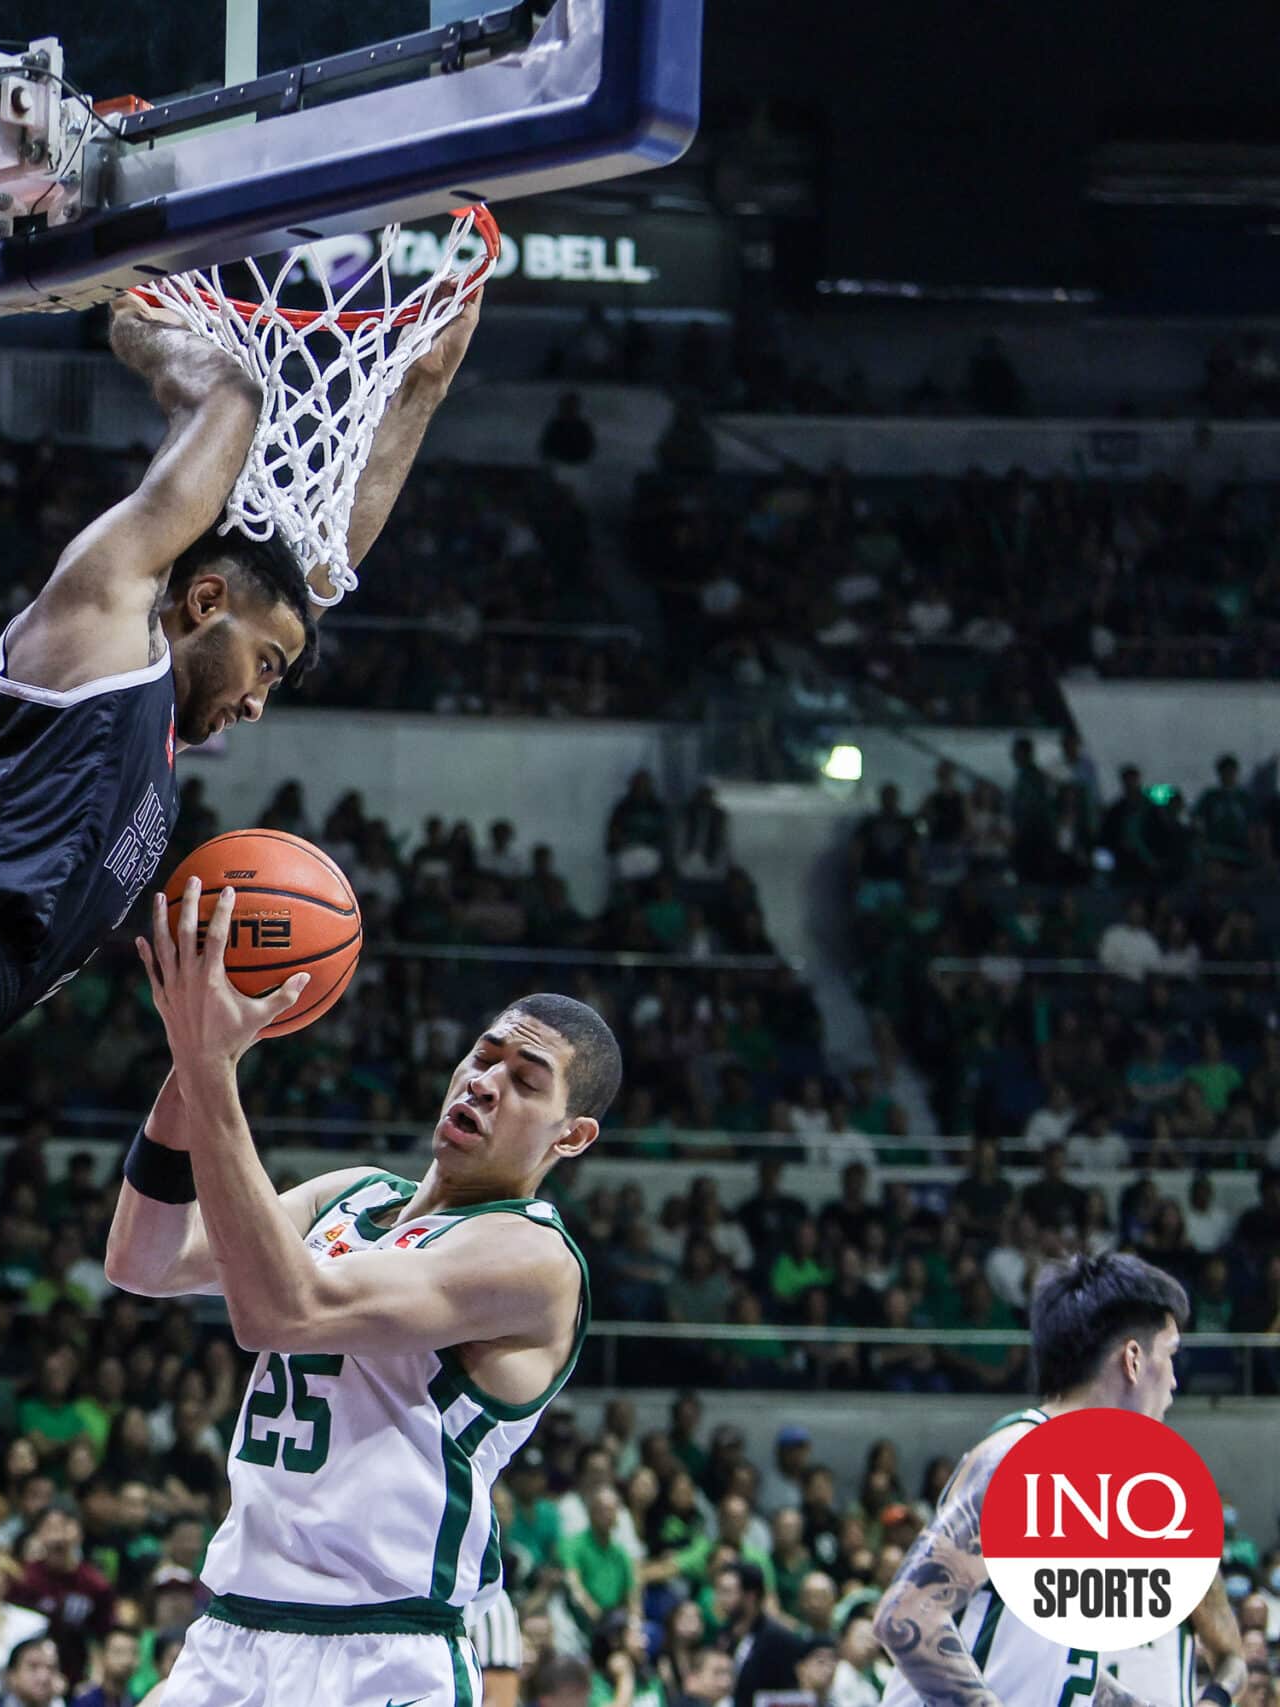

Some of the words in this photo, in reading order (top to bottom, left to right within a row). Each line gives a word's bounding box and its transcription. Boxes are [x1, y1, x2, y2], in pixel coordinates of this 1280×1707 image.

[380, 229, 519, 279] TACO
[524, 232, 652, 284] BELL
[196, 918, 291, 949] ELI
[235, 1352, 344, 1474] 25
